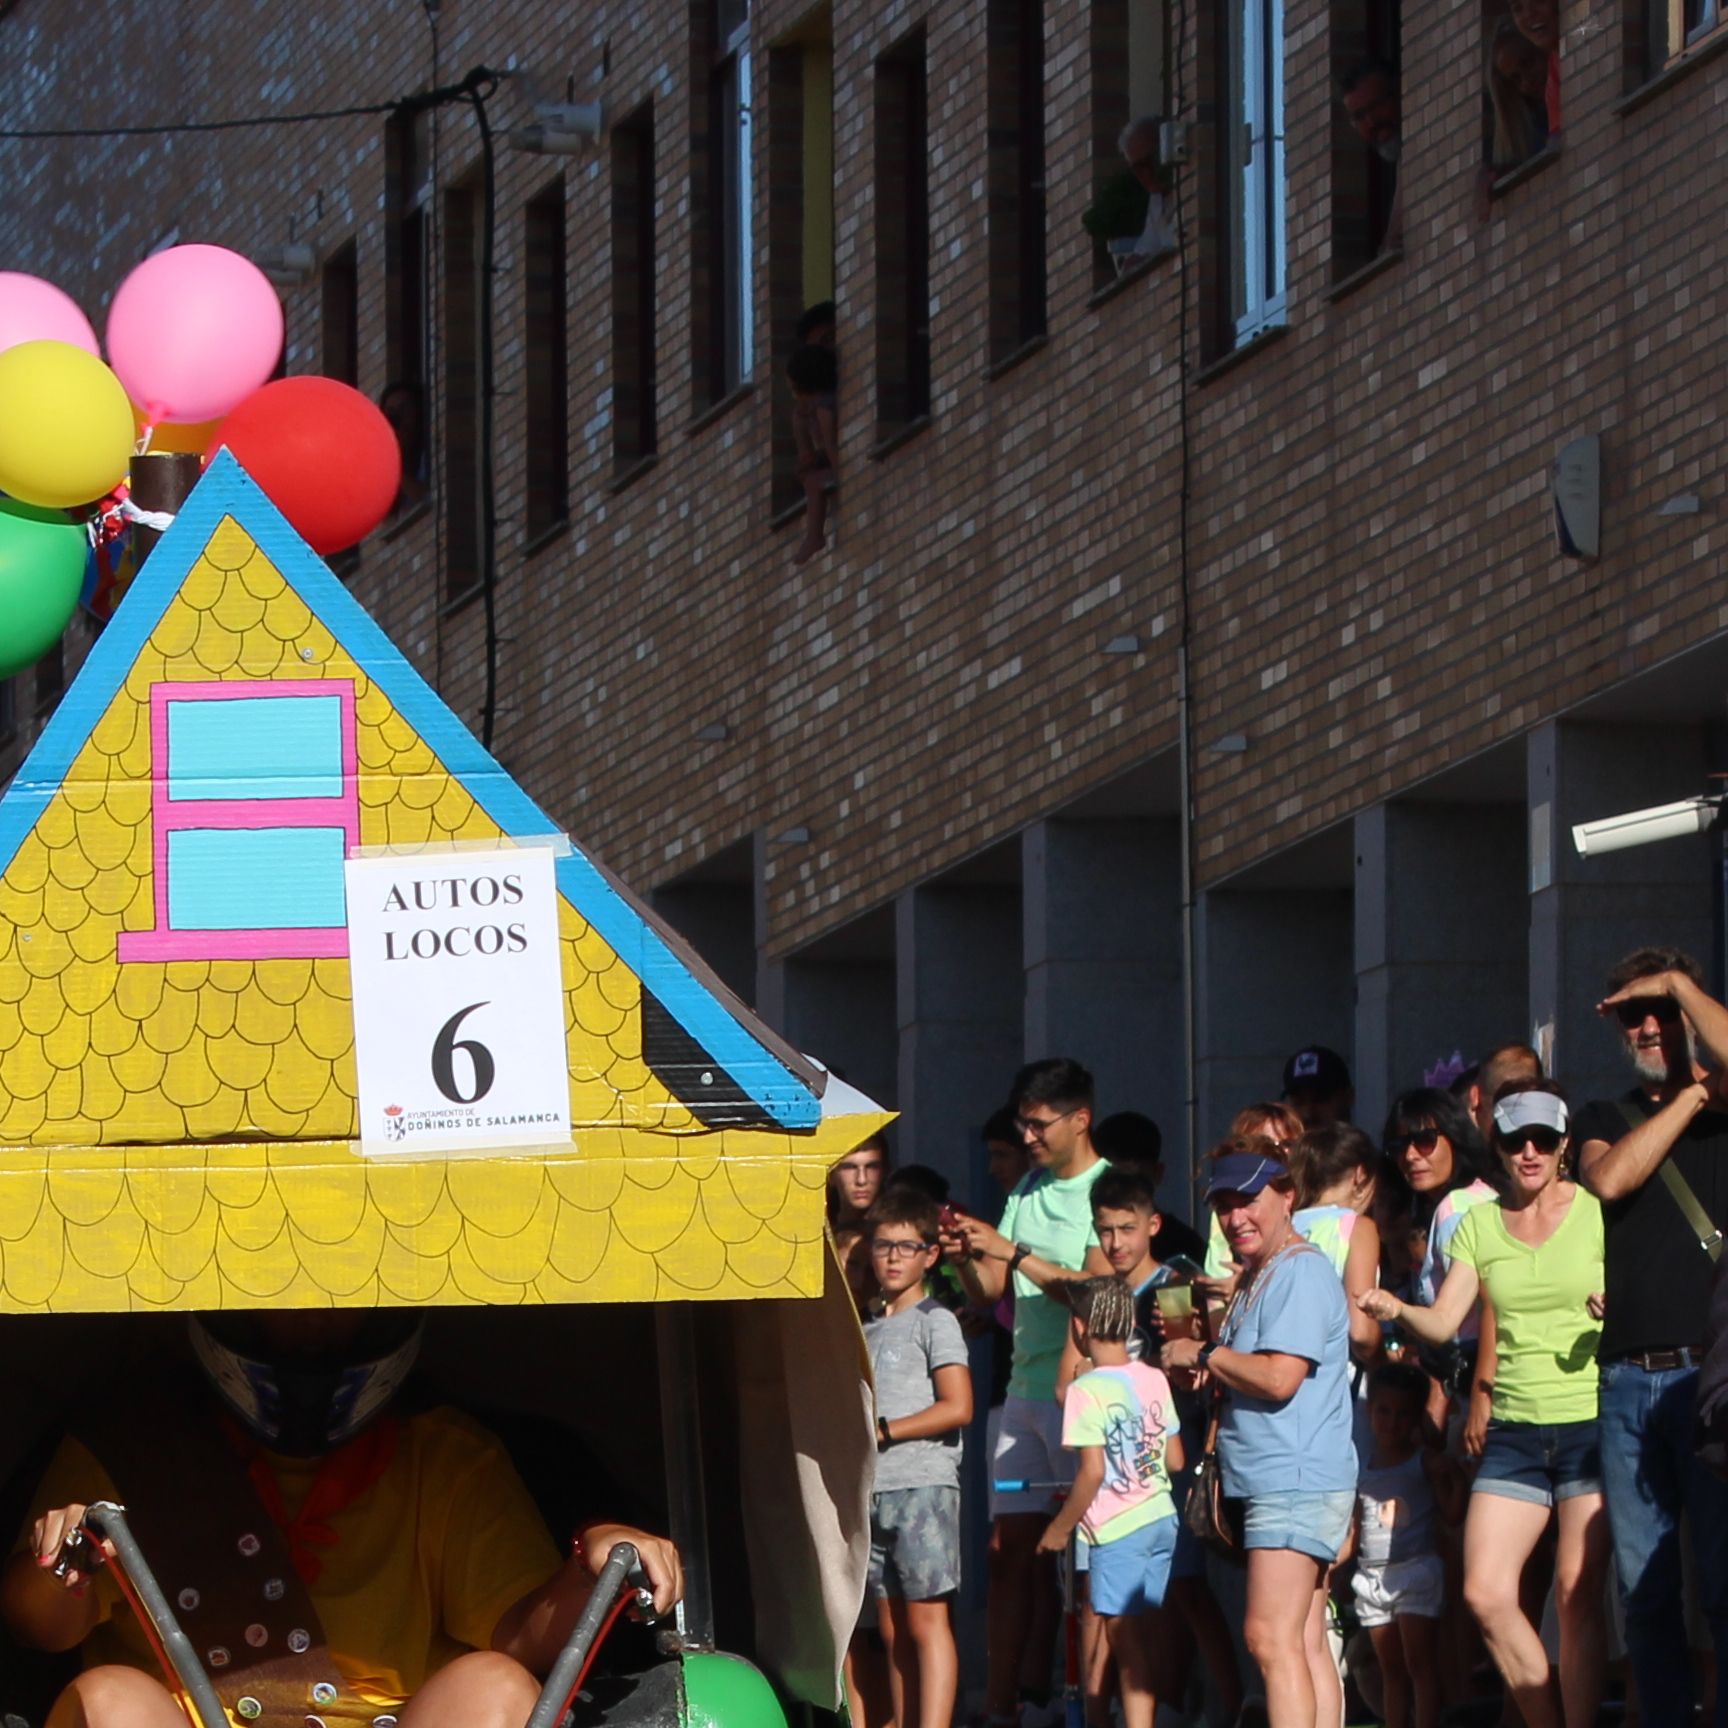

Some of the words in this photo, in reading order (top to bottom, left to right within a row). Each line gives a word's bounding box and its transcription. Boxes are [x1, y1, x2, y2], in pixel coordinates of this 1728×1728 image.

[382, 874, 524, 912] AUTOS
[383, 923, 528, 961] LOCOS
[431, 1000, 495, 1104] 6
[407, 1109, 464, 1119] AYUNTAMIENTO
[465, 1108, 475, 1116] DE
[408, 1117, 461, 1131] DOÑINOS
[466, 1117, 481, 1128] DE
[487, 1113, 560, 1127] SALAMANCA
